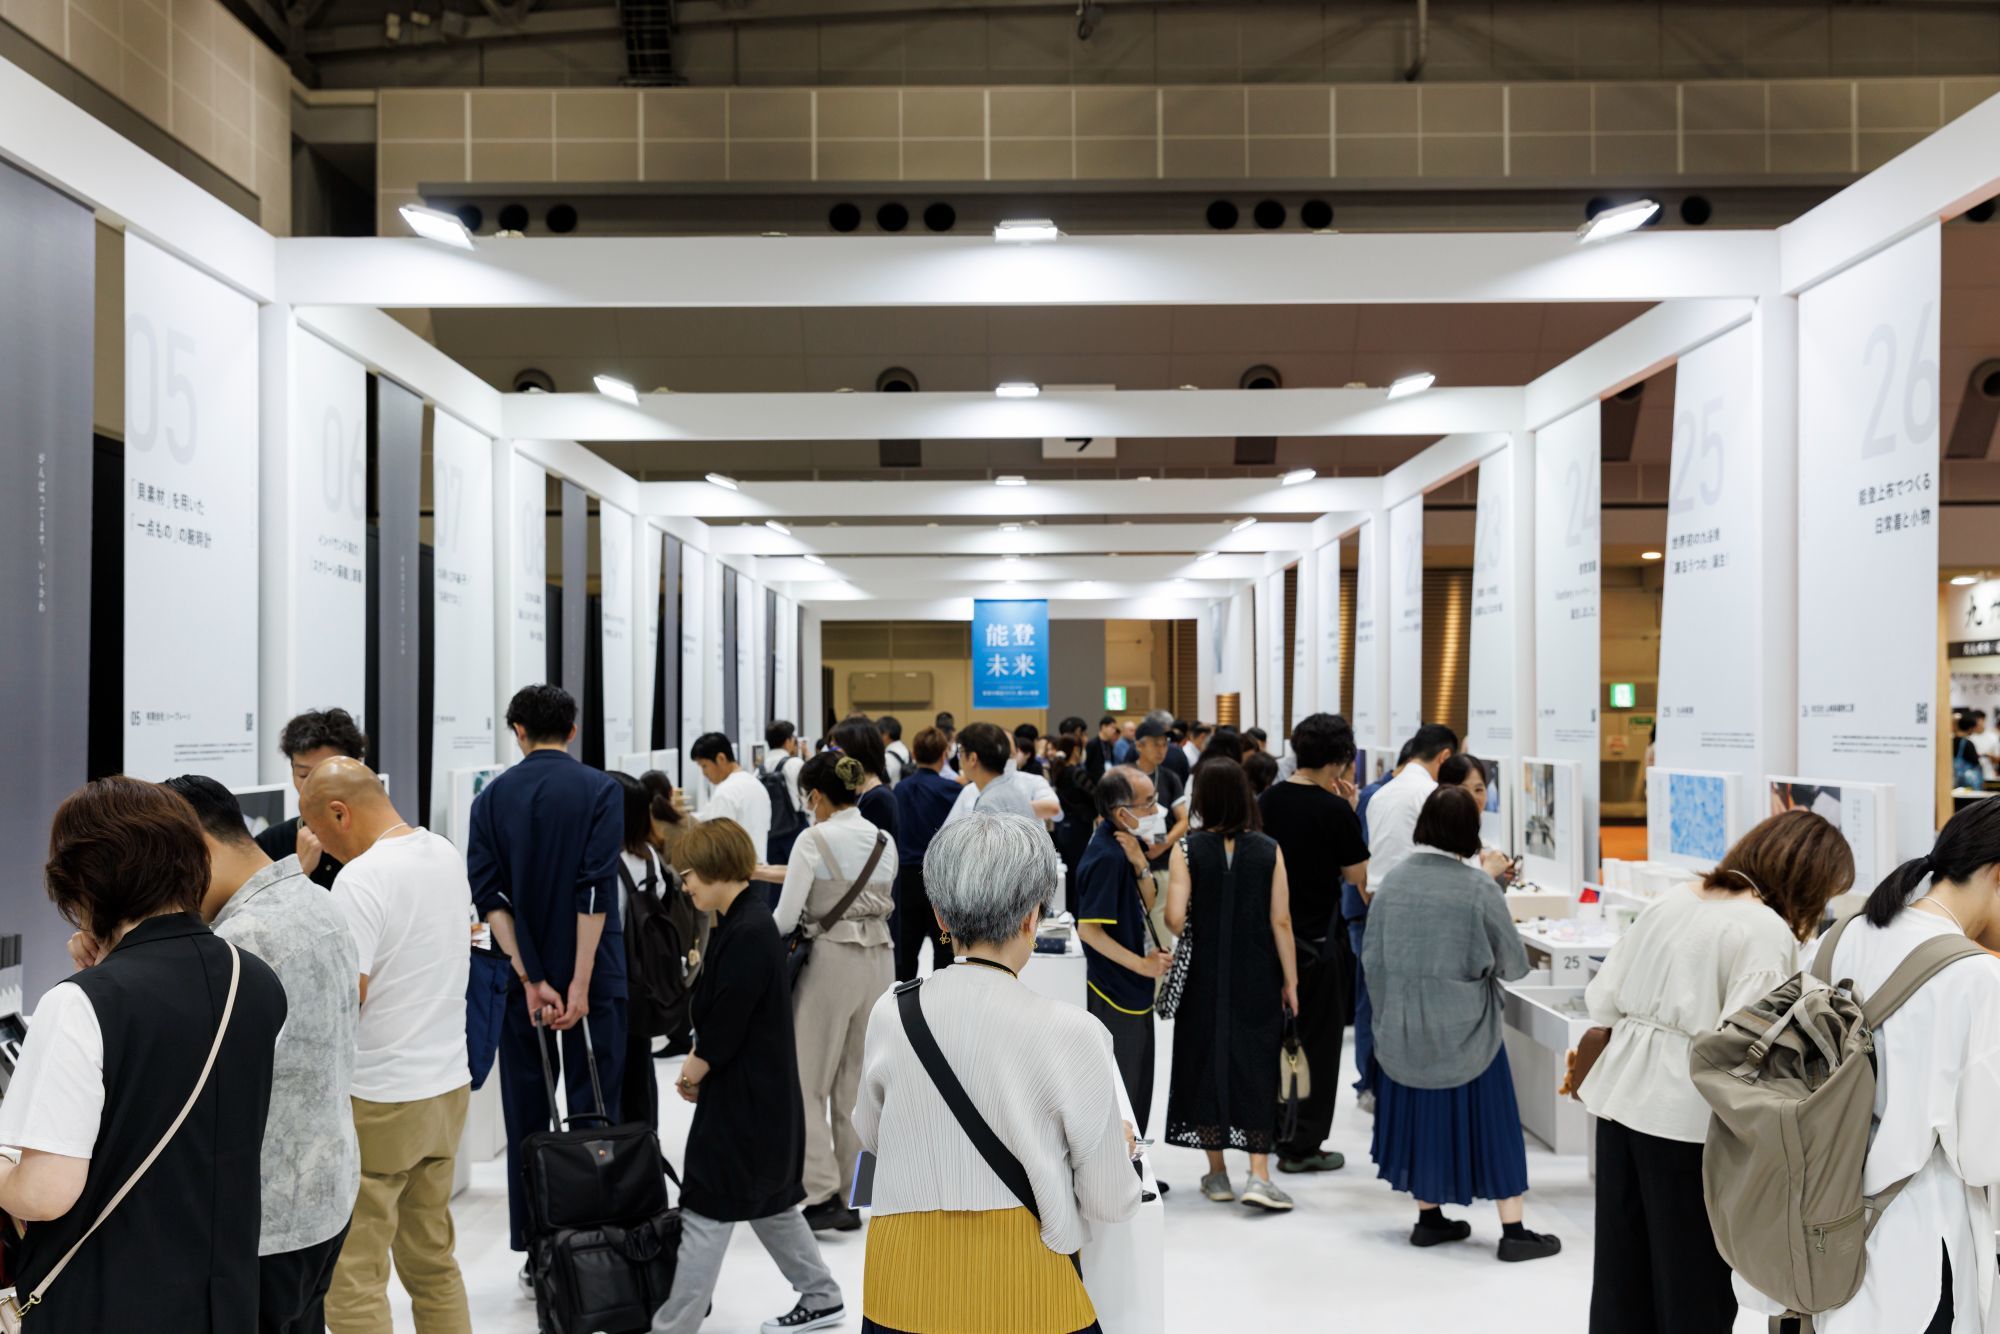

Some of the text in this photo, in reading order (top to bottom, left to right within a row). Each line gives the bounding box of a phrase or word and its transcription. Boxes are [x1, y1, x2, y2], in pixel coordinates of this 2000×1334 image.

[126, 312, 198, 466] 05
[1861, 302, 1938, 460] 26
[1671, 397, 1725, 516] 25
[130, 478, 205, 516] 「貝素材」を用いた
[1858, 472, 1931, 506] 能登上布でつくる
[130, 512, 212, 549] 「一点もの」の腕時計
[1875, 508, 1931, 535] 日常着と小物
[985, 622, 1035, 647] 能登
[985, 653, 1036, 679] 未来
[130, 710, 141, 726] 05
[1563, 955, 1580, 970] 25
